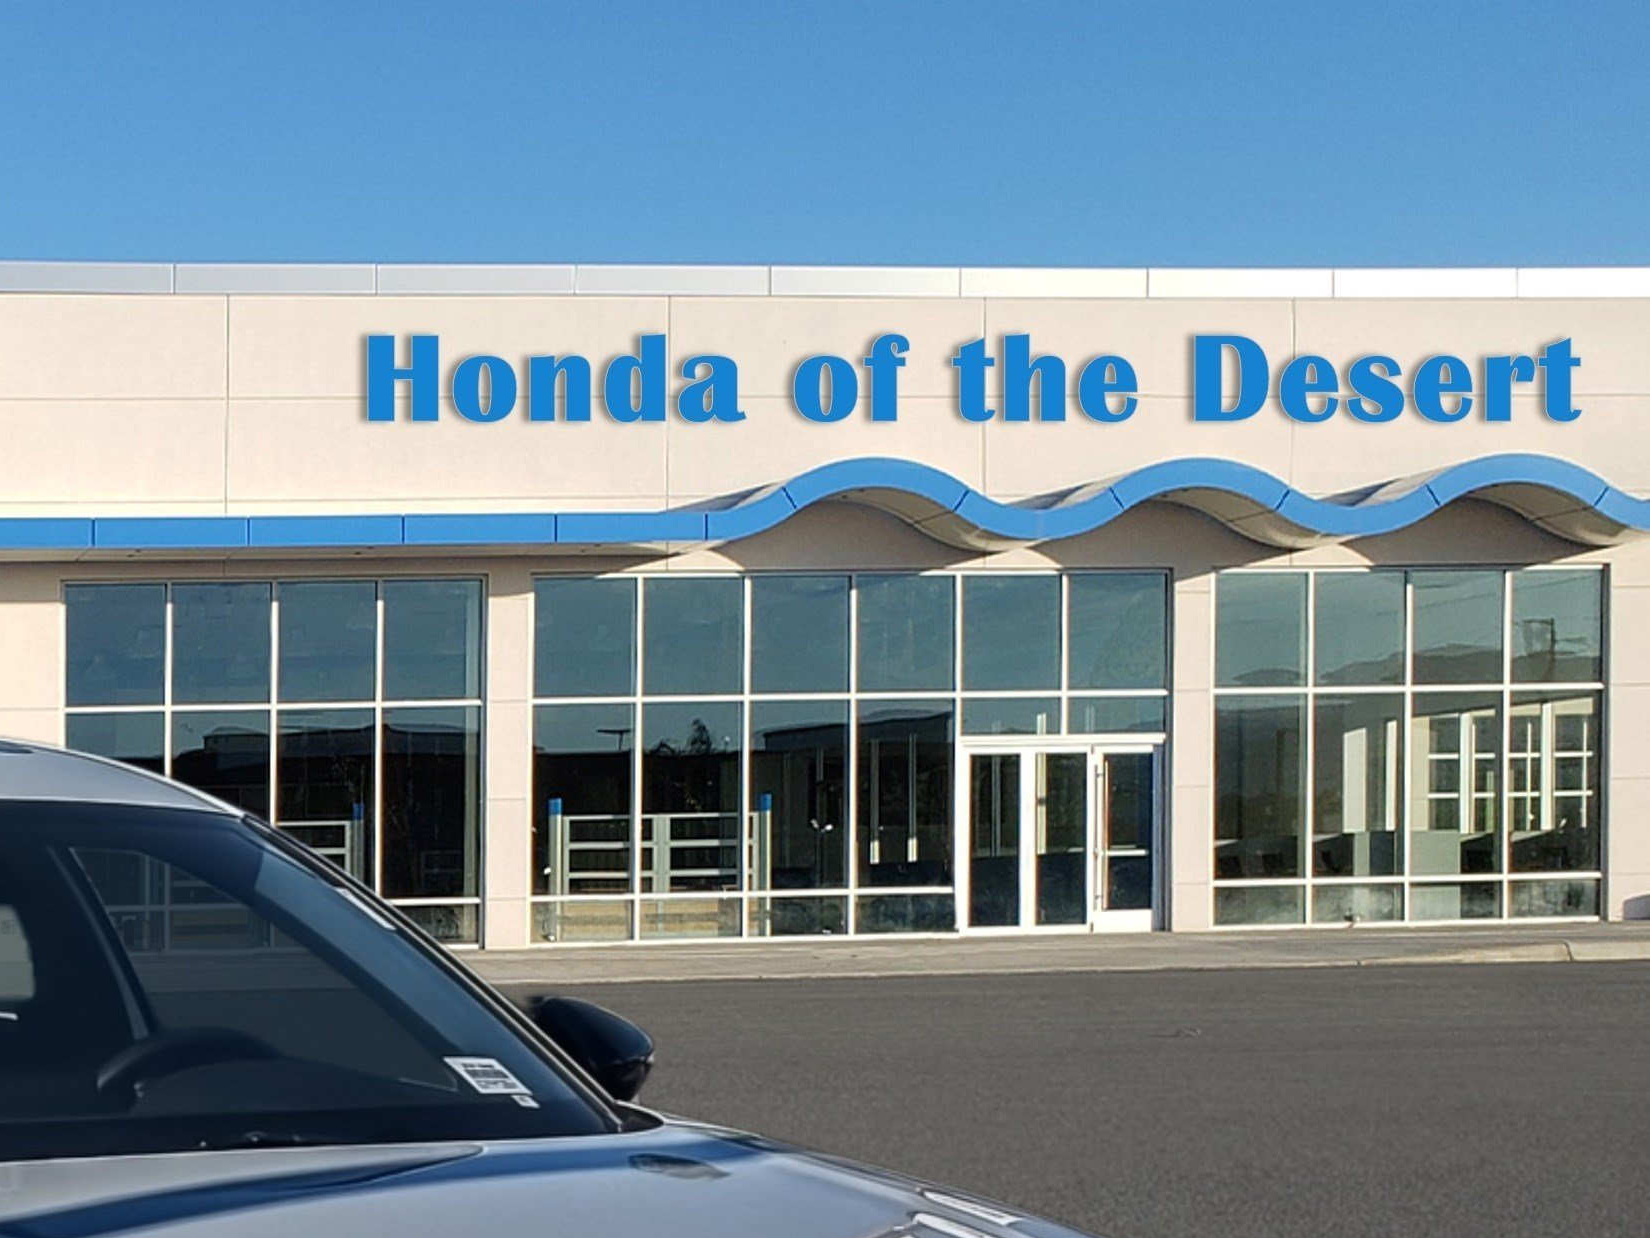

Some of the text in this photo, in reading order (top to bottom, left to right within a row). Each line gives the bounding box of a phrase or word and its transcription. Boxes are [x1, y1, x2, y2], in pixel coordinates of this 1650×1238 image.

[365, 332, 1583, 424] Honda of the Desert
